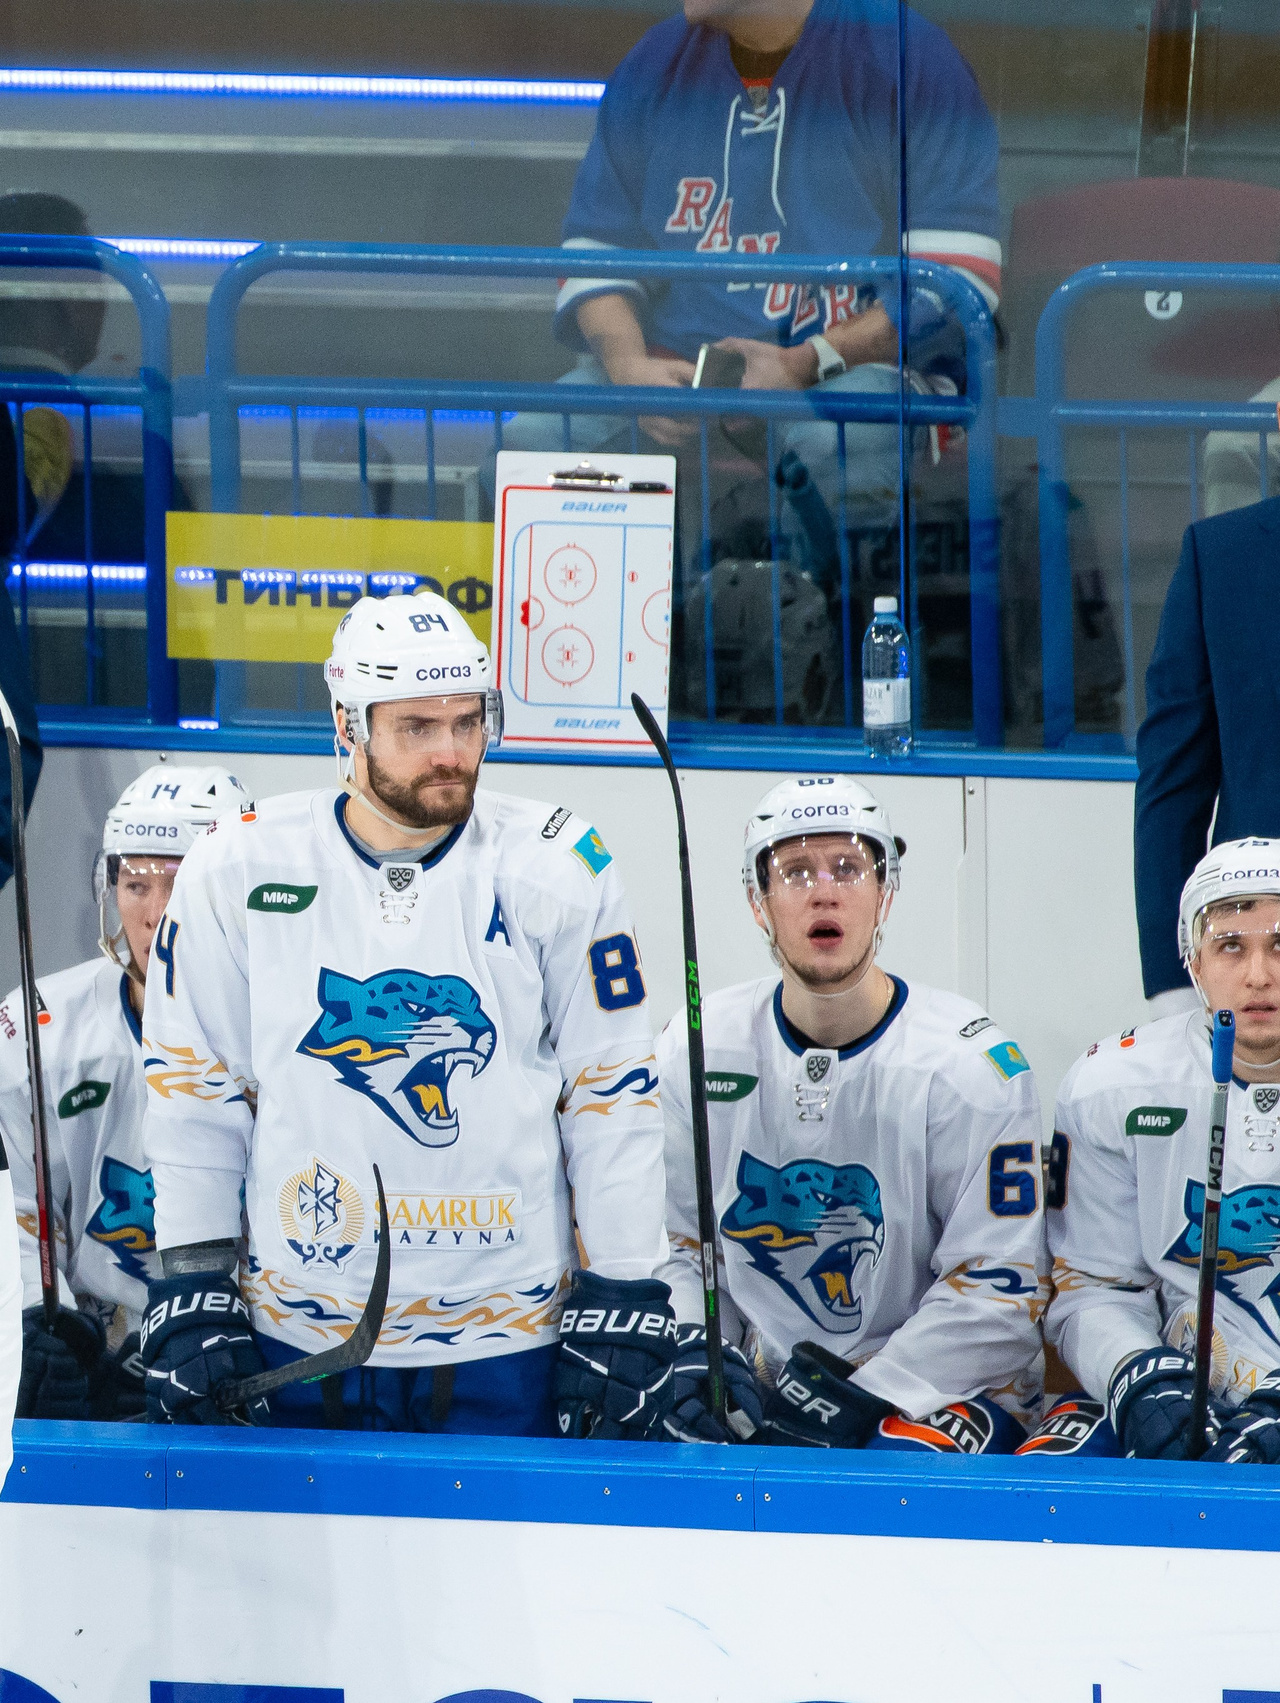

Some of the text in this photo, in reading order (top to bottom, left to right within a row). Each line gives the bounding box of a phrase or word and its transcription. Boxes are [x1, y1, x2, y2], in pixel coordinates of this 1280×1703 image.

[409, 613, 450, 633] 84
[328, 663, 345, 679] Forte
[416, 665, 472, 681] согаз
[151, 783, 182, 800] 14
[791, 804, 849, 819] согаз
[124, 823, 178, 838] согаз
[263, 891, 299, 905] МИР
[485, 895, 512, 947] A
[686, 959, 701, 1031] CCM
[705, 1080, 738, 1093] МИР
[1137, 1114, 1171, 1127] МИР
[1208, 1124, 1225, 1191] CCM
[986, 1139, 1039, 1220] 6
